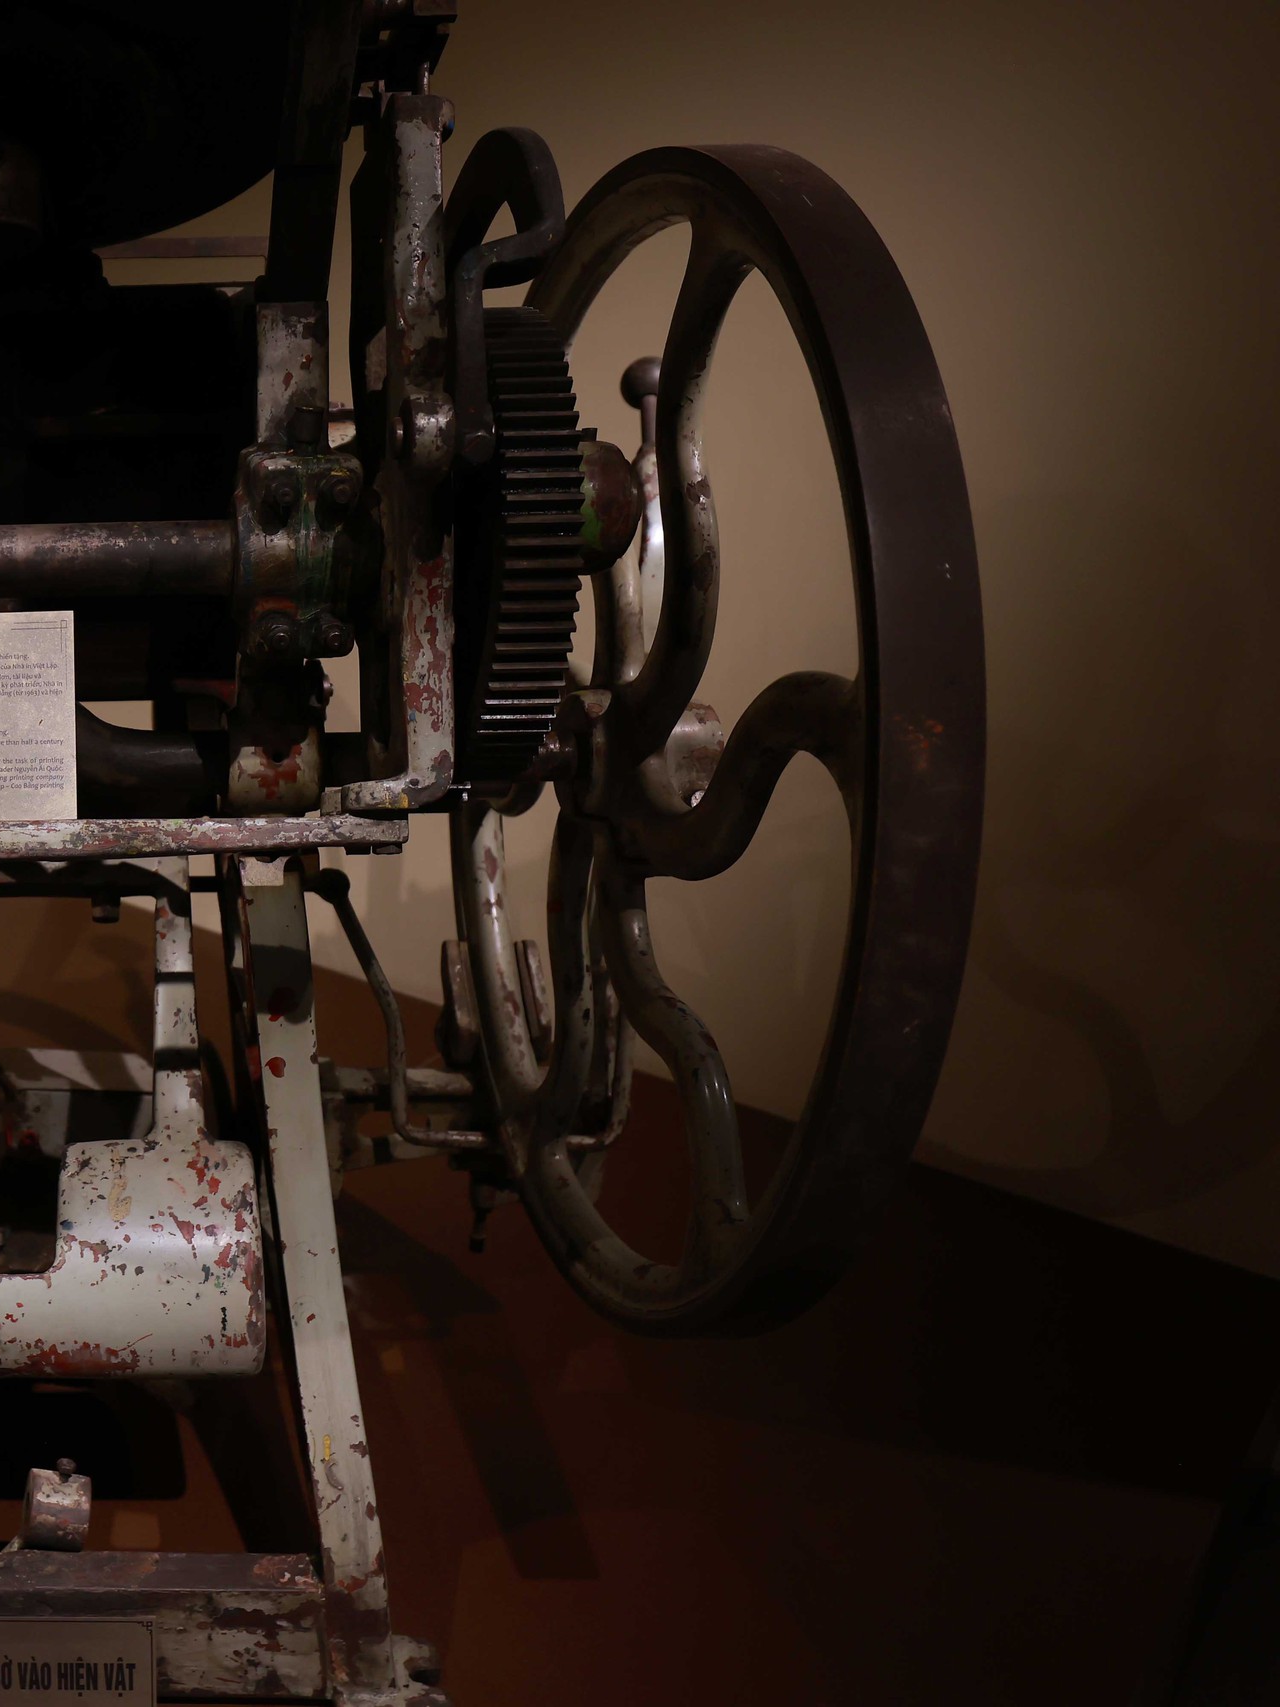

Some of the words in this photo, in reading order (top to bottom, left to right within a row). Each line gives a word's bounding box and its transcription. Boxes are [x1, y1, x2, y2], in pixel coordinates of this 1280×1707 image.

[39, 757, 64, 765] printing
[40, 782, 64, 790] printing
[18, 1656, 50, 1690] VÀO
[58, 1657, 98, 1697] HIỆN
[104, 1657, 136, 1697] VẬT
